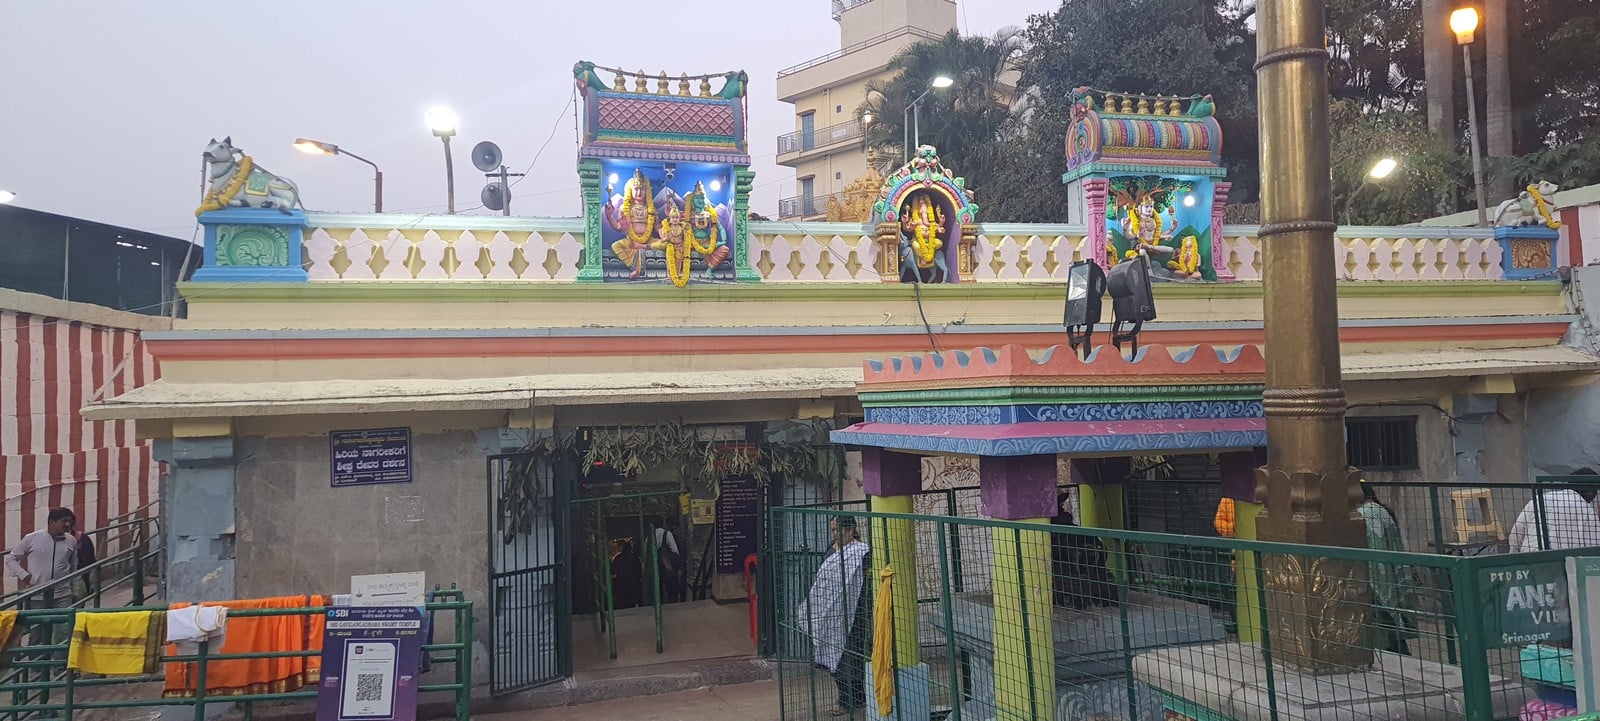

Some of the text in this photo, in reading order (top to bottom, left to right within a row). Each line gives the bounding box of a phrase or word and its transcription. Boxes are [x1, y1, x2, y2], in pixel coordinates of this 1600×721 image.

[335, 449, 360, 459] ಹಿರಿಯ
[356, 460, 380, 470] ದೇವರ
[382, 458, 406, 468] ದರ್ಶನ
[1516, 570, 1530, 580] BY
[335, 609, 349, 618] SBI
[1502, 632, 1551, 644] Srinagar
